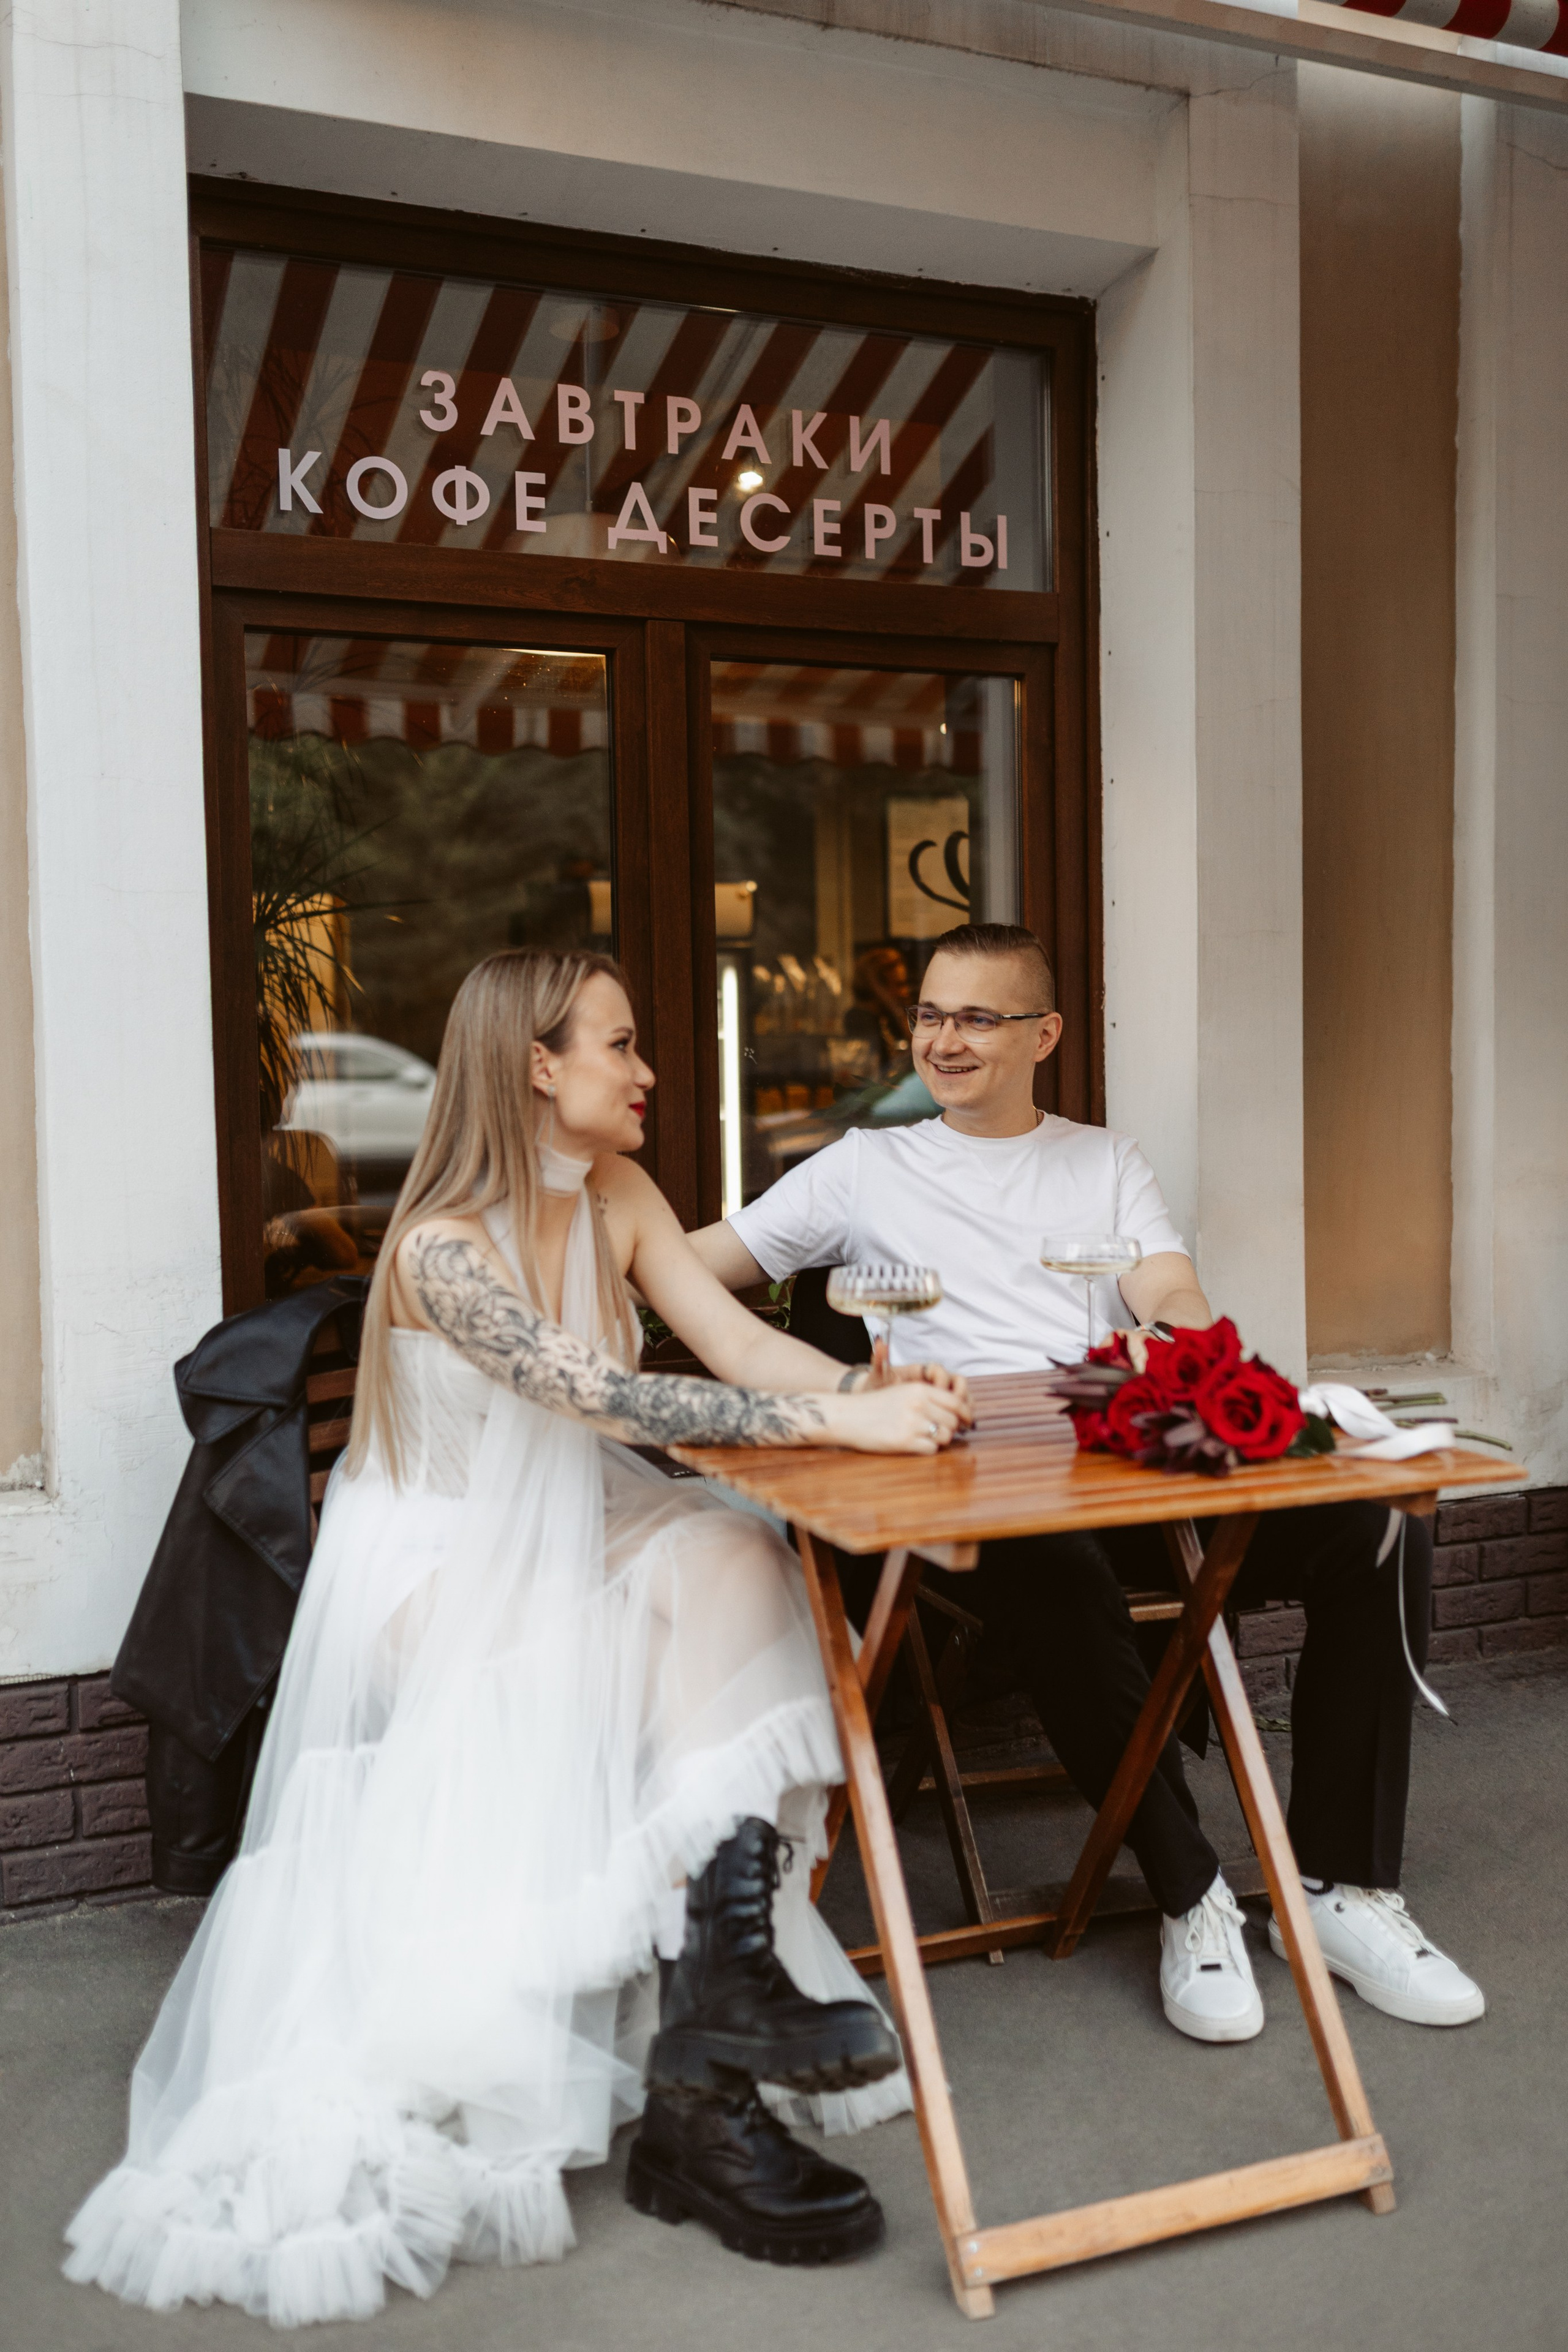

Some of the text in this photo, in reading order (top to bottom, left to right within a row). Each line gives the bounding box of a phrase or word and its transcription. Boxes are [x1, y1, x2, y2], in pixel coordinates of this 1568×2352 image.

[420, 370, 891, 475] ЗАВТРАКИ
[277, 448, 1008, 570] КОФЕ ДЕСЕРТЫ
